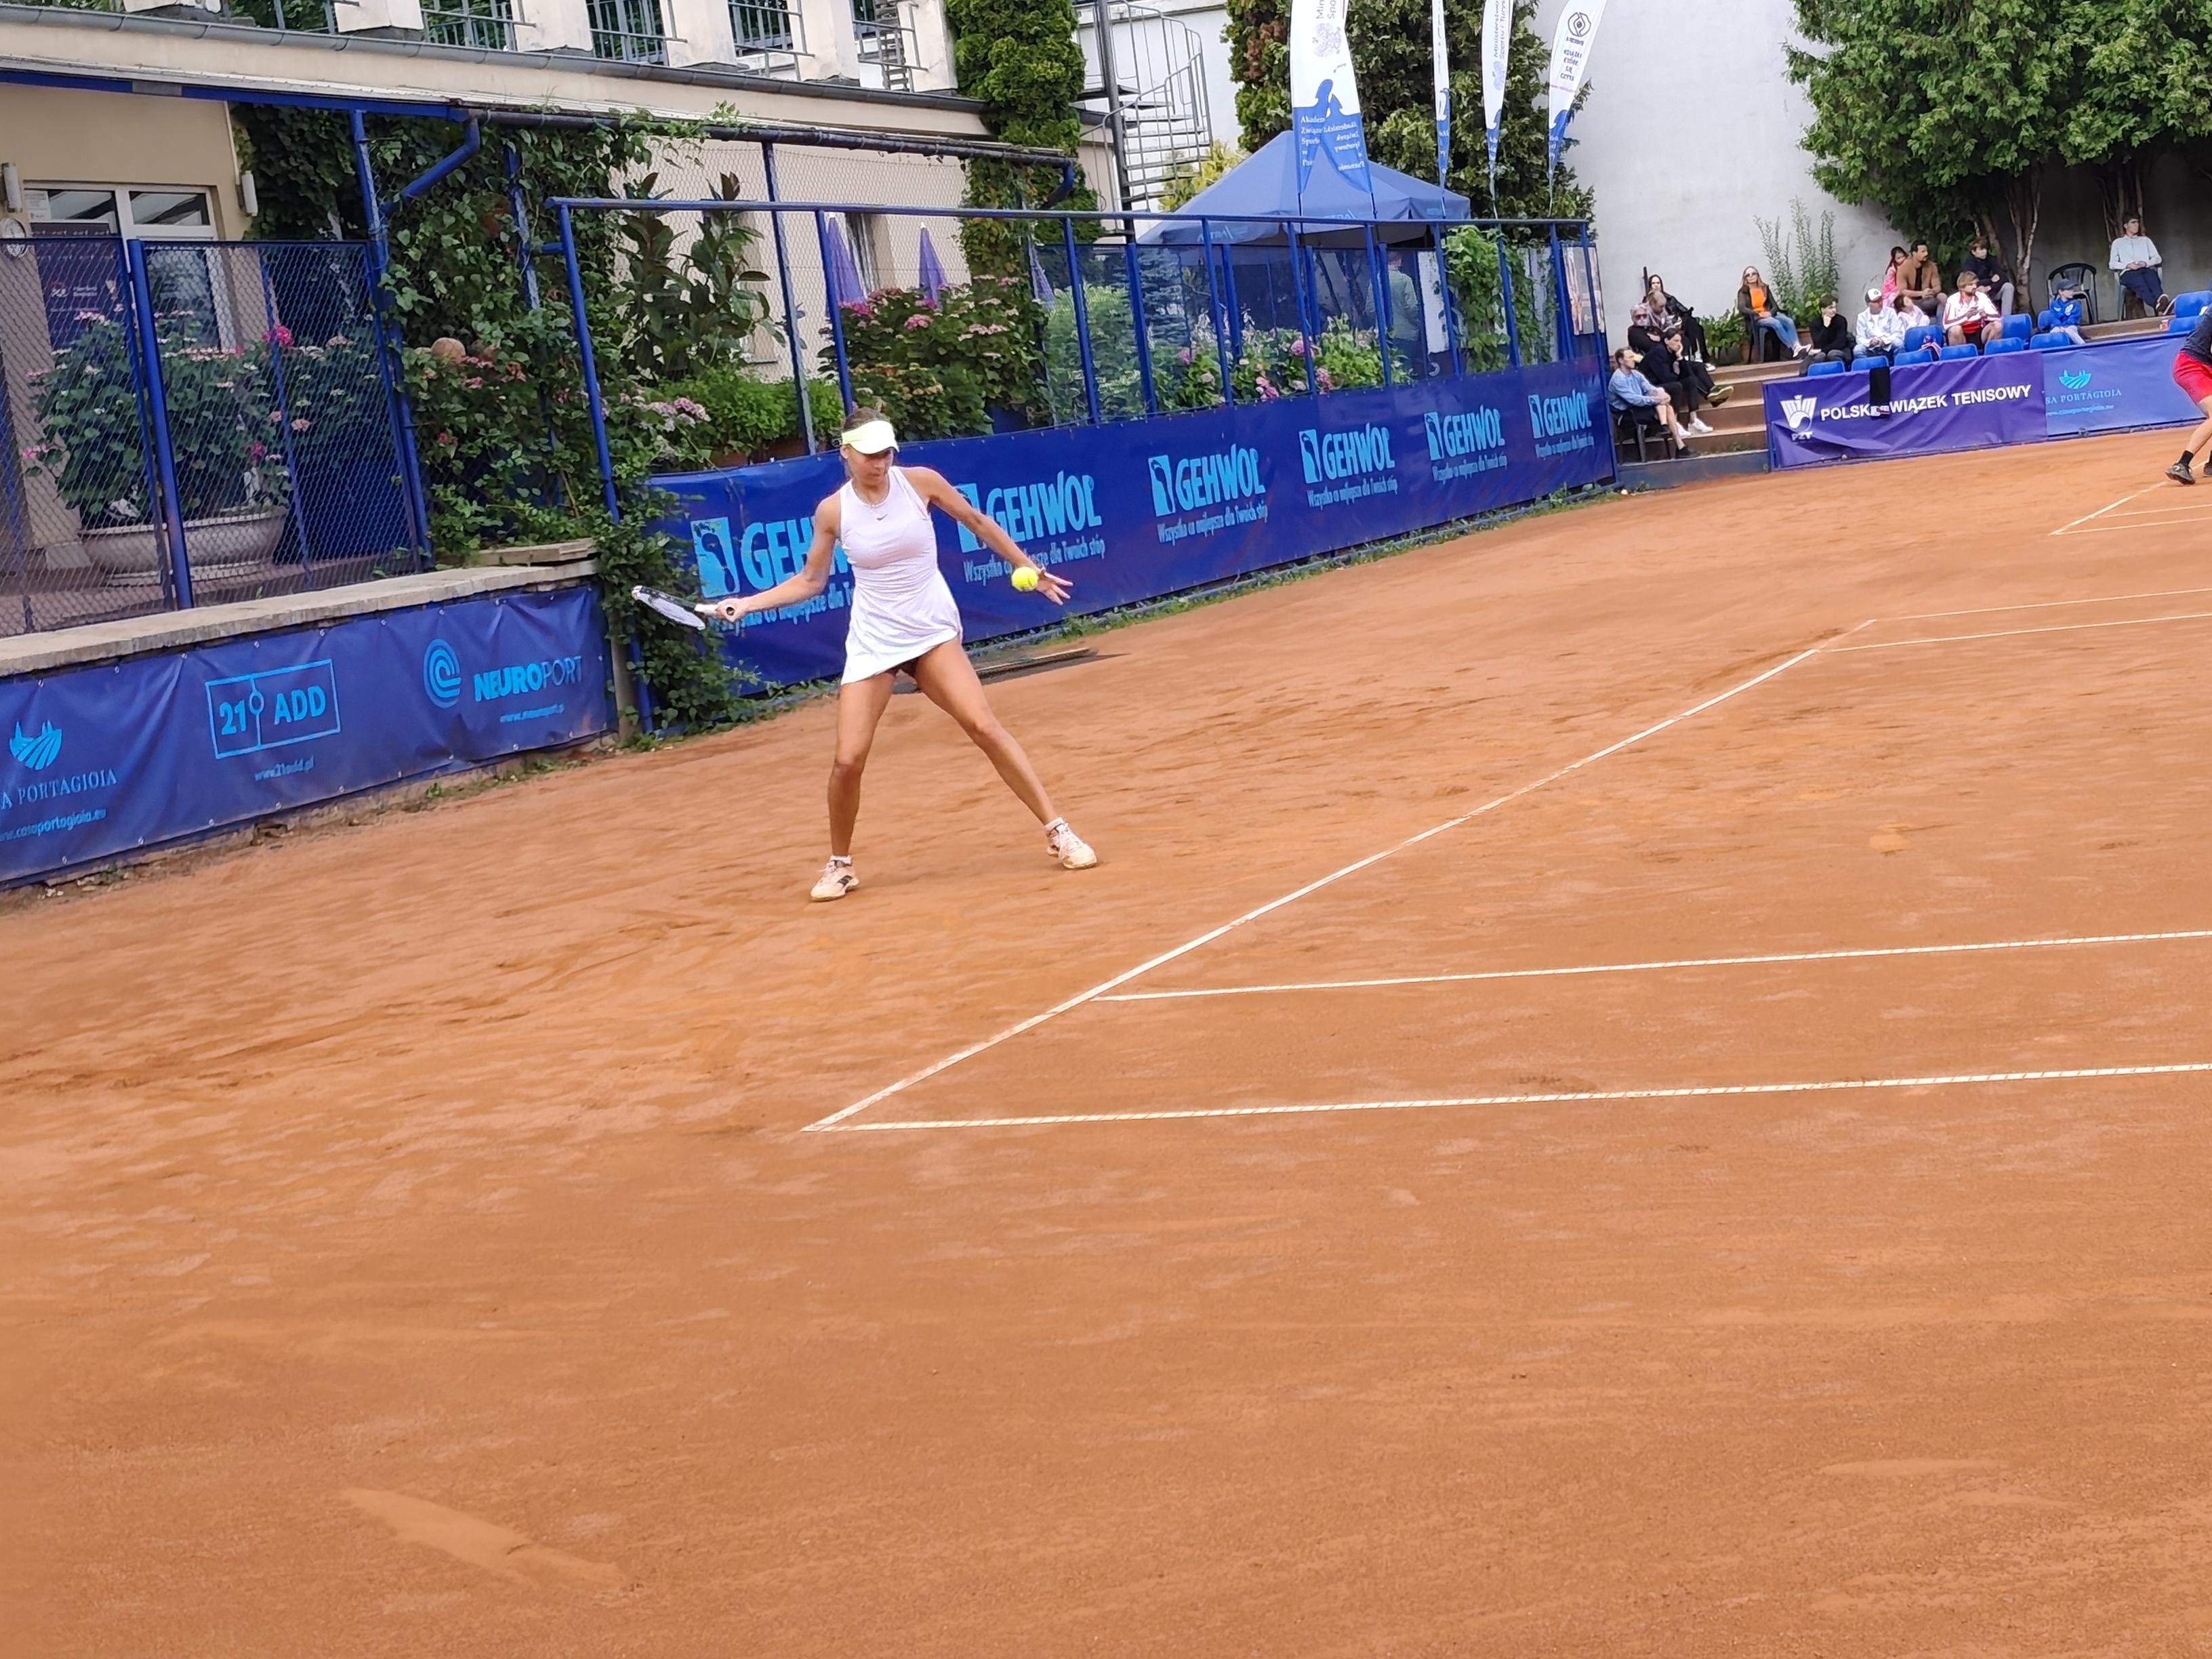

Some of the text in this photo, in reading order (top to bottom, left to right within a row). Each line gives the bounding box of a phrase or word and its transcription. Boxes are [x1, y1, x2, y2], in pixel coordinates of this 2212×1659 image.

[1821, 384, 2032, 421] POLSK WIĄZEK TENISOWY
[1322, 422, 1396, 480] GEHWOL
[1443, 404, 1505, 457] GEHWOL
[1791, 431, 1814, 441] PZT
[1175, 443, 1266, 511] GEHWOL
[986, 470, 1103, 542] GEHWOL
[474, 655, 582, 702] NEUROPORT
[219, 685, 326, 735] 21 ADD
[18, 769, 117, 805] PORTAGIOIA
